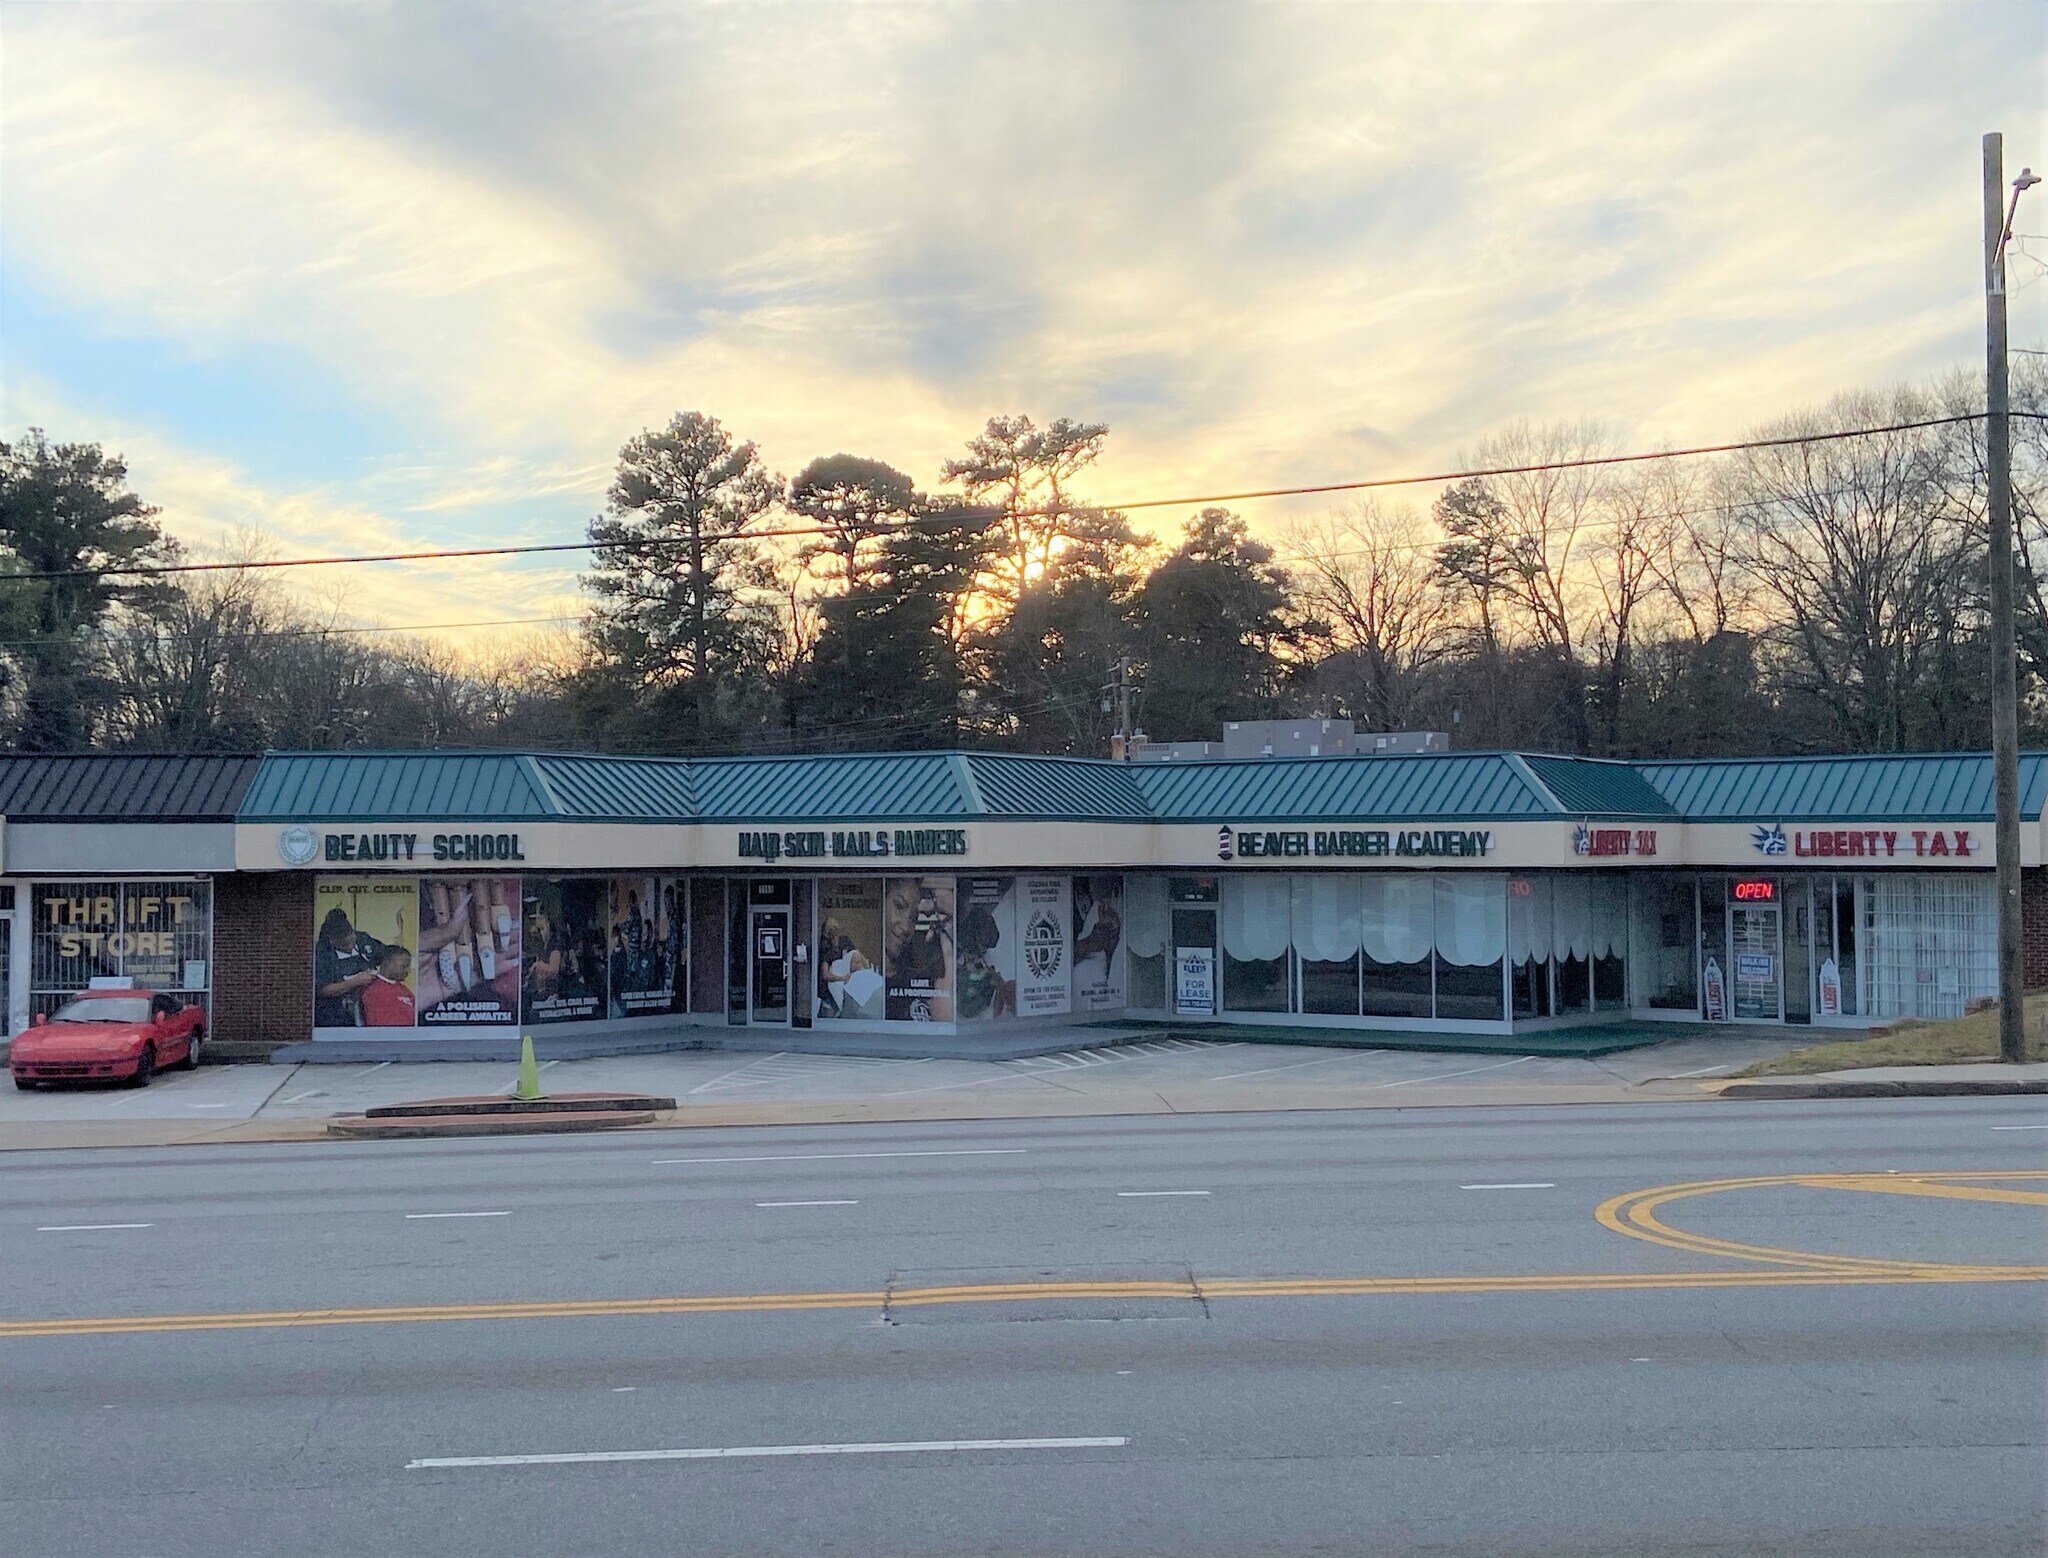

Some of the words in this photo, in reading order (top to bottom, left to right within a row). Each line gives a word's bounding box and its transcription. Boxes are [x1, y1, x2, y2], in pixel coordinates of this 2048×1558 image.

[325, 834, 417, 861] BEAUTY
[433, 834, 525, 861] SCHOOL
[738, 831, 780, 857] HAIR
[784, 831, 826, 857] SKIN
[832, 831, 888, 857] NAILS
[894, 829, 967, 856] BARBERS
[1238, 832, 1308, 857] BEAVER
[1314, 831, 1389, 857] BARBER
[1395, 831, 1490, 857] ACADEMY
[1588, 830, 1631, 856] LIBERTY
[1636, 830, 1657, 855] TAX
[1795, 831, 1897, 857] LIBERTY
[1912, 831, 1971, 857] TAX
[1735, 883, 1772, 899] OPEN
[44, 896, 190, 925] THRIFT
[60, 932, 175, 957] STORE
[1180, 989, 1211, 999] LEASE
[1185, 980, 1205, 988] FOR
[425, 1011, 468, 1021] CAREER
[436, 1002, 446, 1011] A
[447, 1001, 500, 1011] POLISHED
